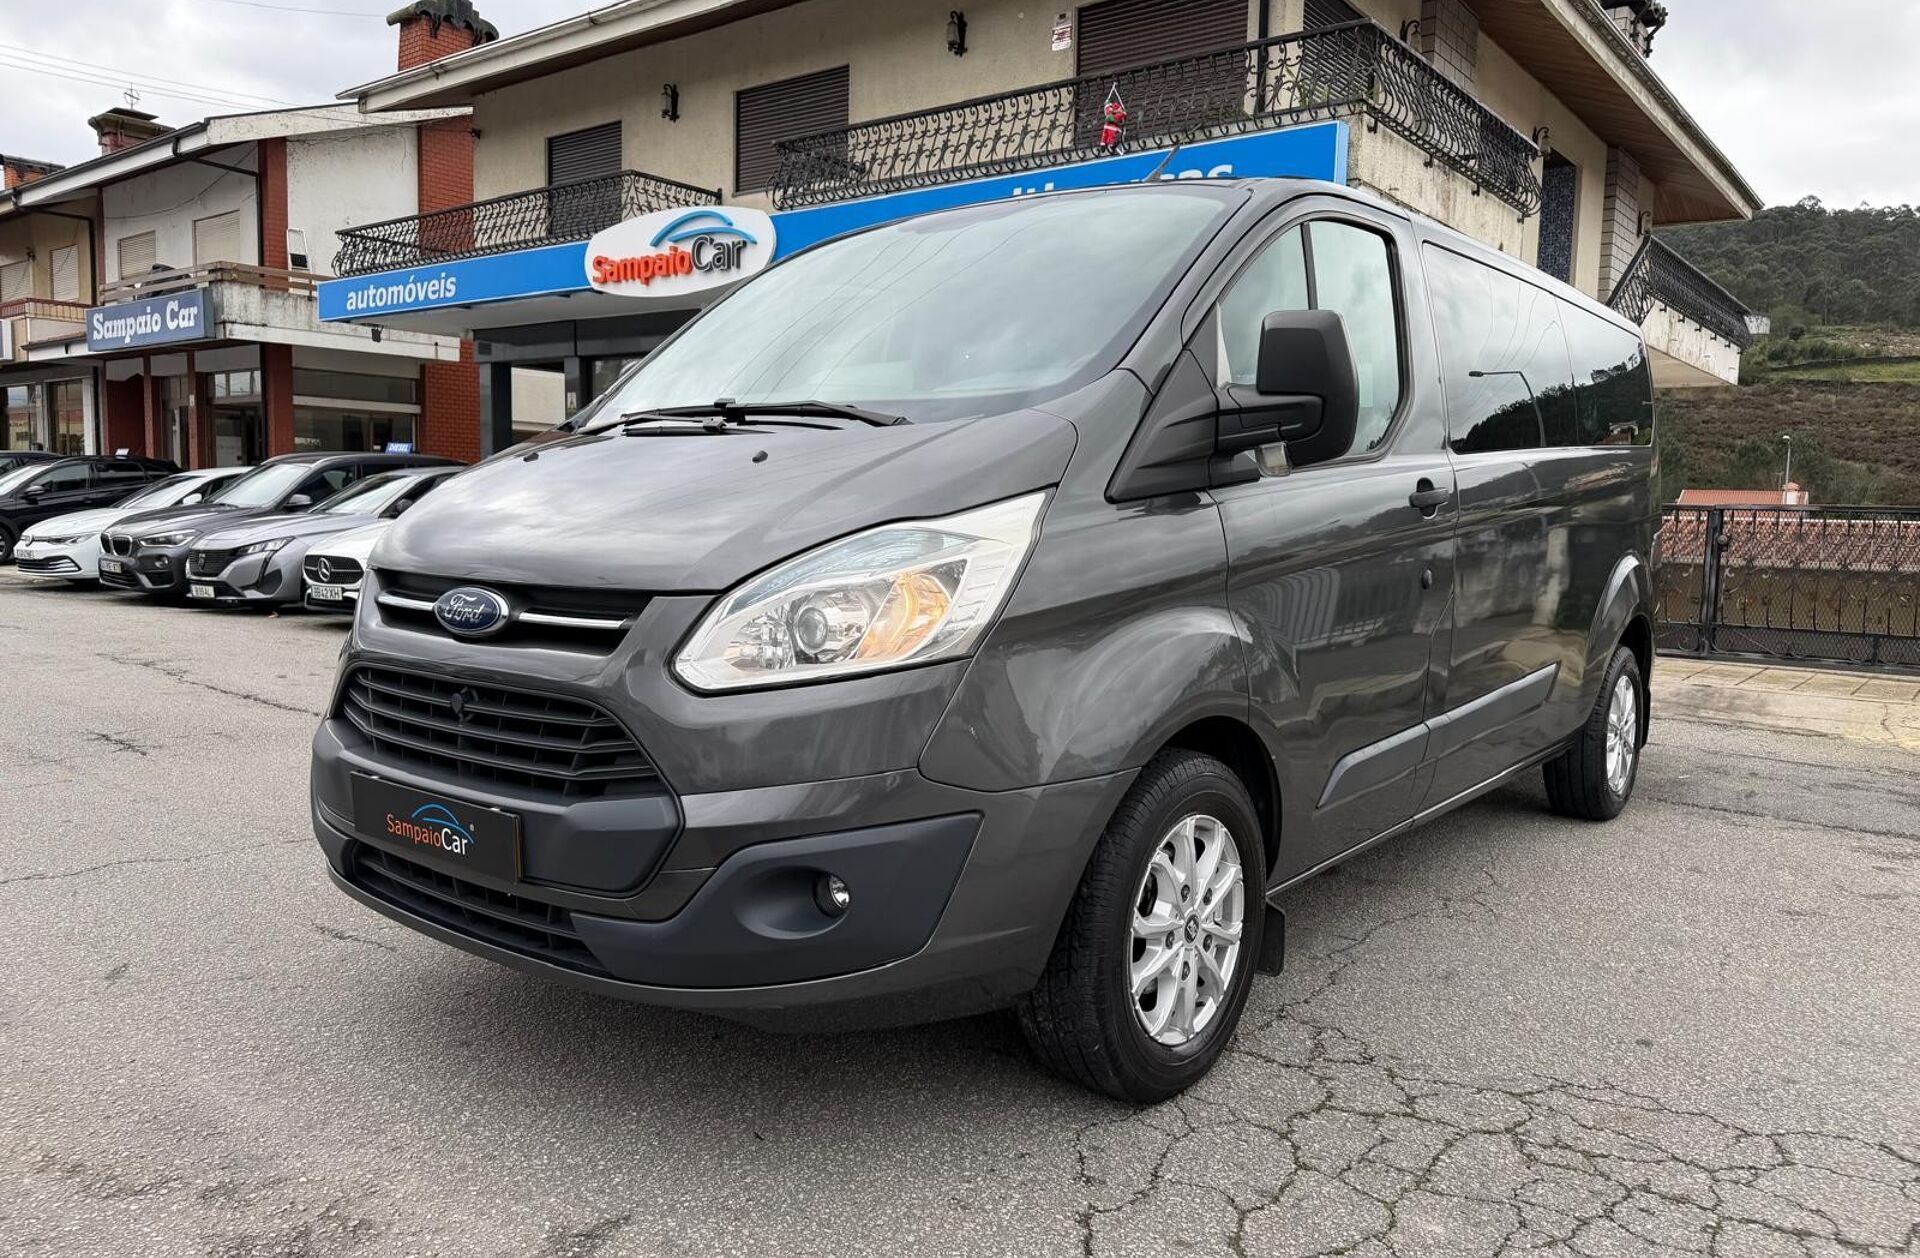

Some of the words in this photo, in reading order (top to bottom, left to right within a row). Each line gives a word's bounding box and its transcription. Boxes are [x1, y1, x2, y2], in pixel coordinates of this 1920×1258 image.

[346, 272, 457, 311] automóveis
[93, 306, 161, 344] Sampaio
[166, 300, 198, 330] Car
[444, 593, 485, 623] Ford
[386, 813, 468, 855] SampaioCar
